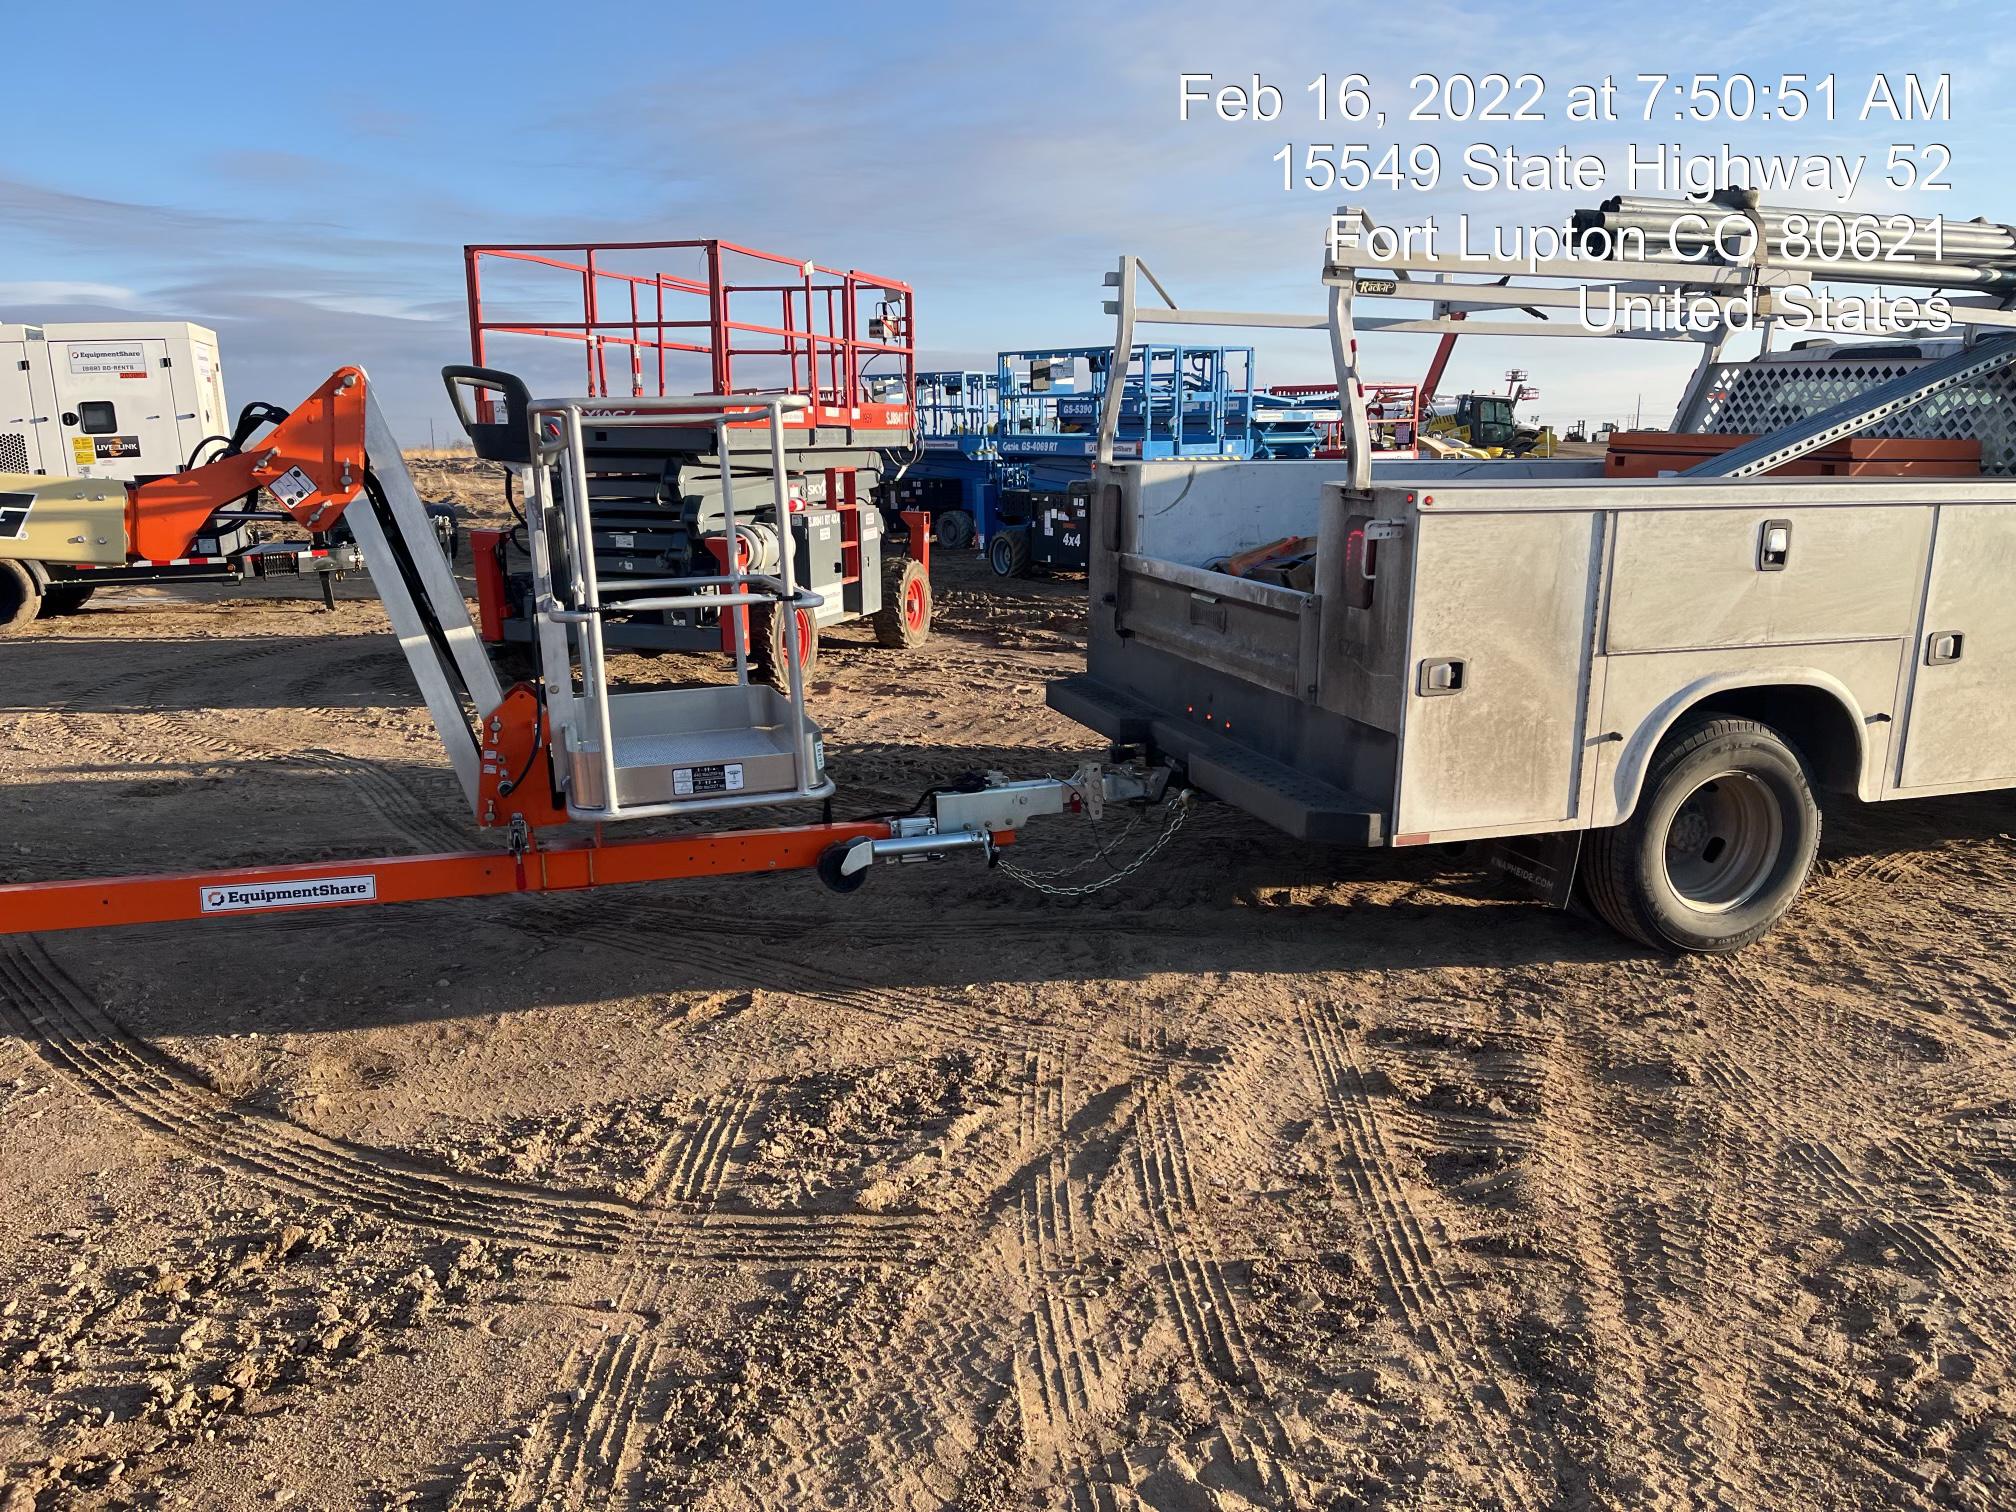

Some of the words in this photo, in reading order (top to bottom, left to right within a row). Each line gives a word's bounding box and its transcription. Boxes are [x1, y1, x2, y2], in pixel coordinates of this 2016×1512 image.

[80, 351, 141, 359] EquipmentShare
[1063, 404, 1093, 414] GS-5390
[1062, 533, 1081, 547] 4x4
[228, 884, 367, 904] EquipmentShare
